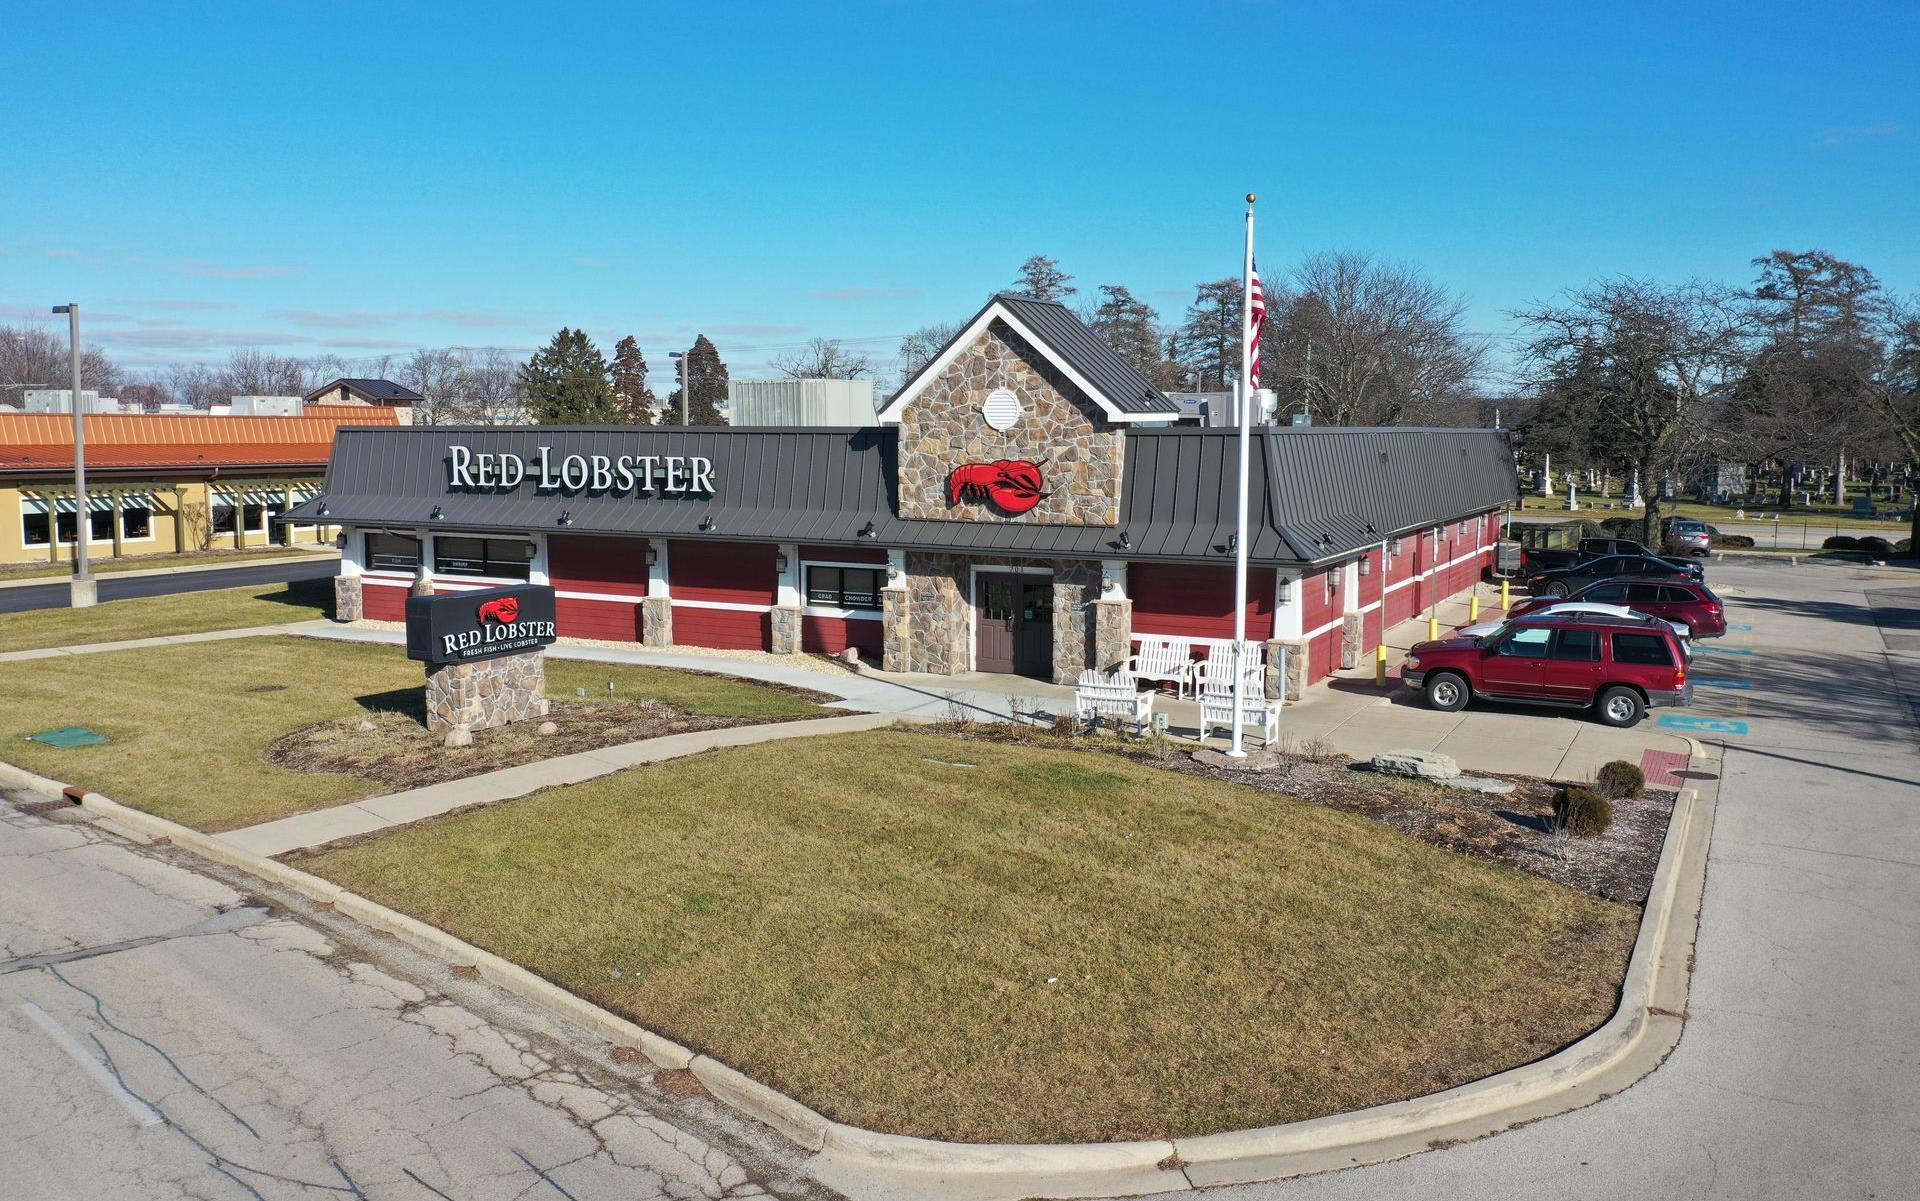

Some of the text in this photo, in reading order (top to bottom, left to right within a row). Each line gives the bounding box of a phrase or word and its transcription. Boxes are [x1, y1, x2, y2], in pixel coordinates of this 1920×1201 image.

[449, 445, 716, 493] RED LOBSTER
[844, 595, 873, 603] CHOWDER
[443, 621, 555, 654] RED LOBSTER
[463, 638, 538, 657] FRESH FISH LIVE LOBSTER
